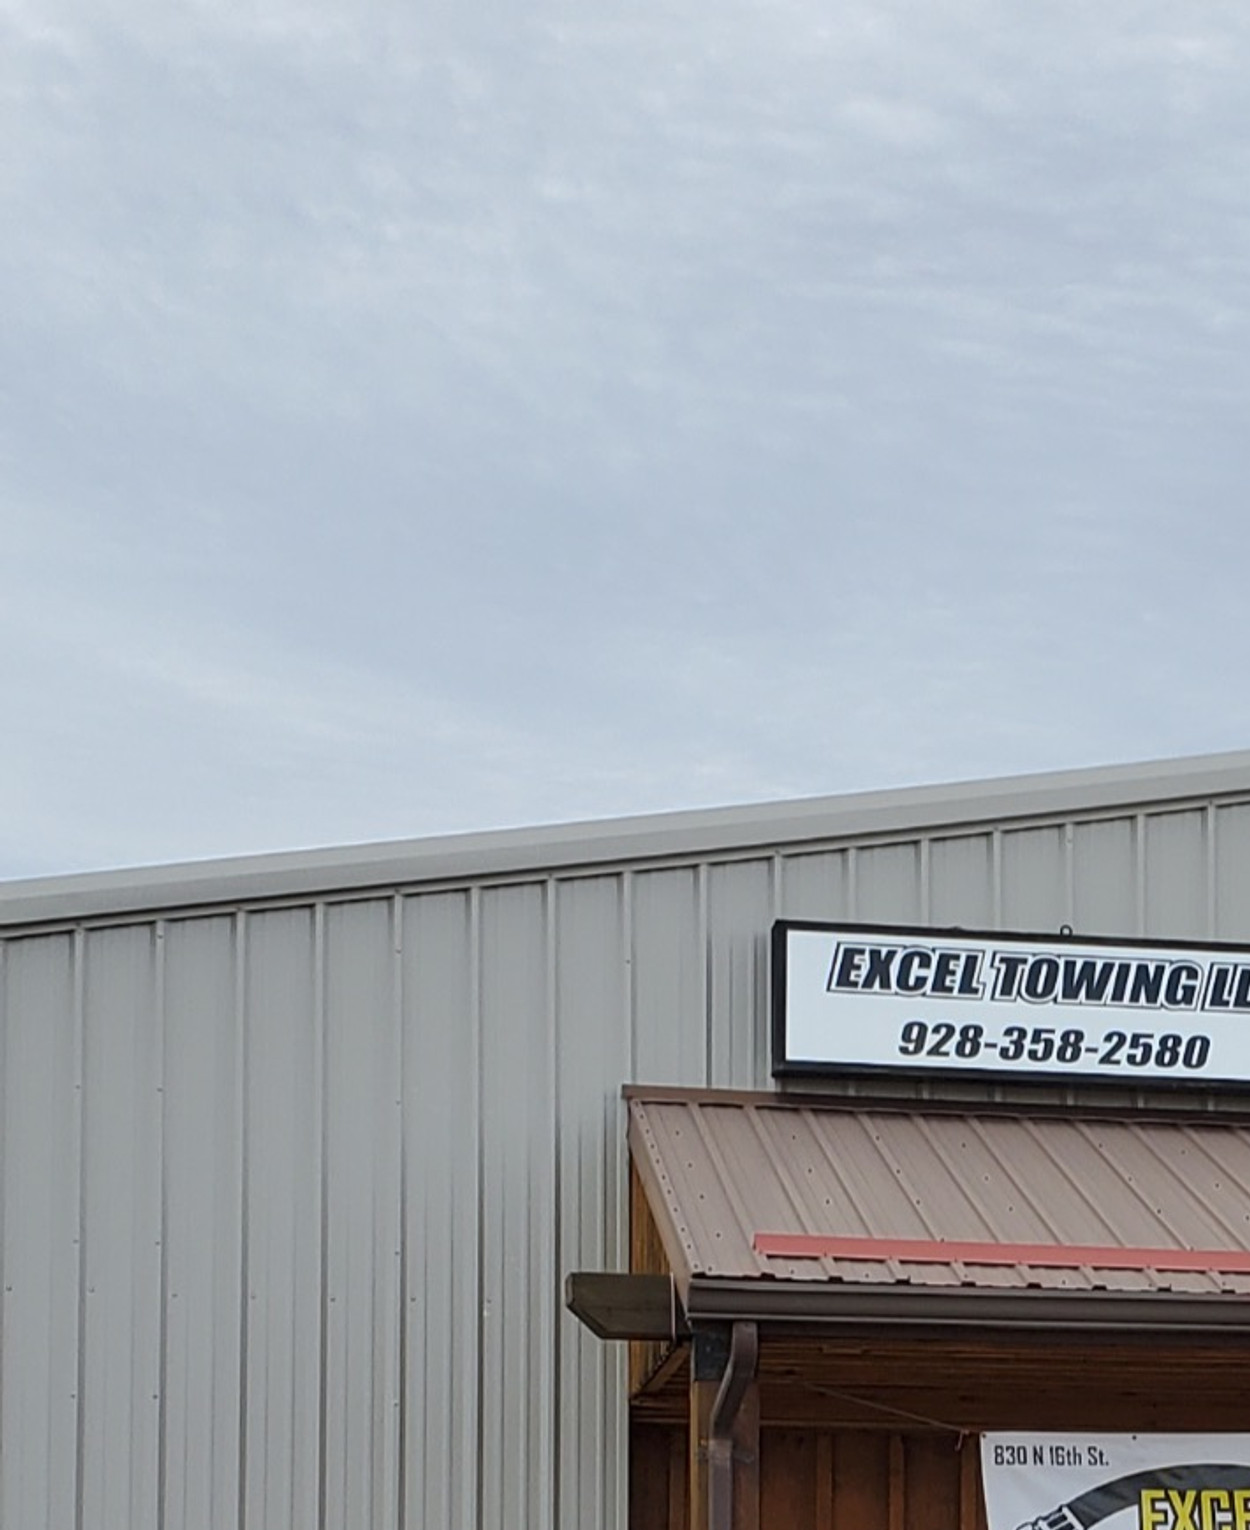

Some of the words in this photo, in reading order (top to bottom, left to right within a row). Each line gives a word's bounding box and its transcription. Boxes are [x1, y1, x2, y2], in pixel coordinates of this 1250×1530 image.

[827, 942, 986, 1001] EXCEL
[990, 951, 1202, 1013] TOWING
[898, 1020, 1211, 1069] 928-358-2580
[994, 1445, 1027, 1466] 830
[1033, 1445, 1043, 1466] N
[1049, 1445, 1082, 1466] 16th
[1088, 1445, 1109, 1466] St.
